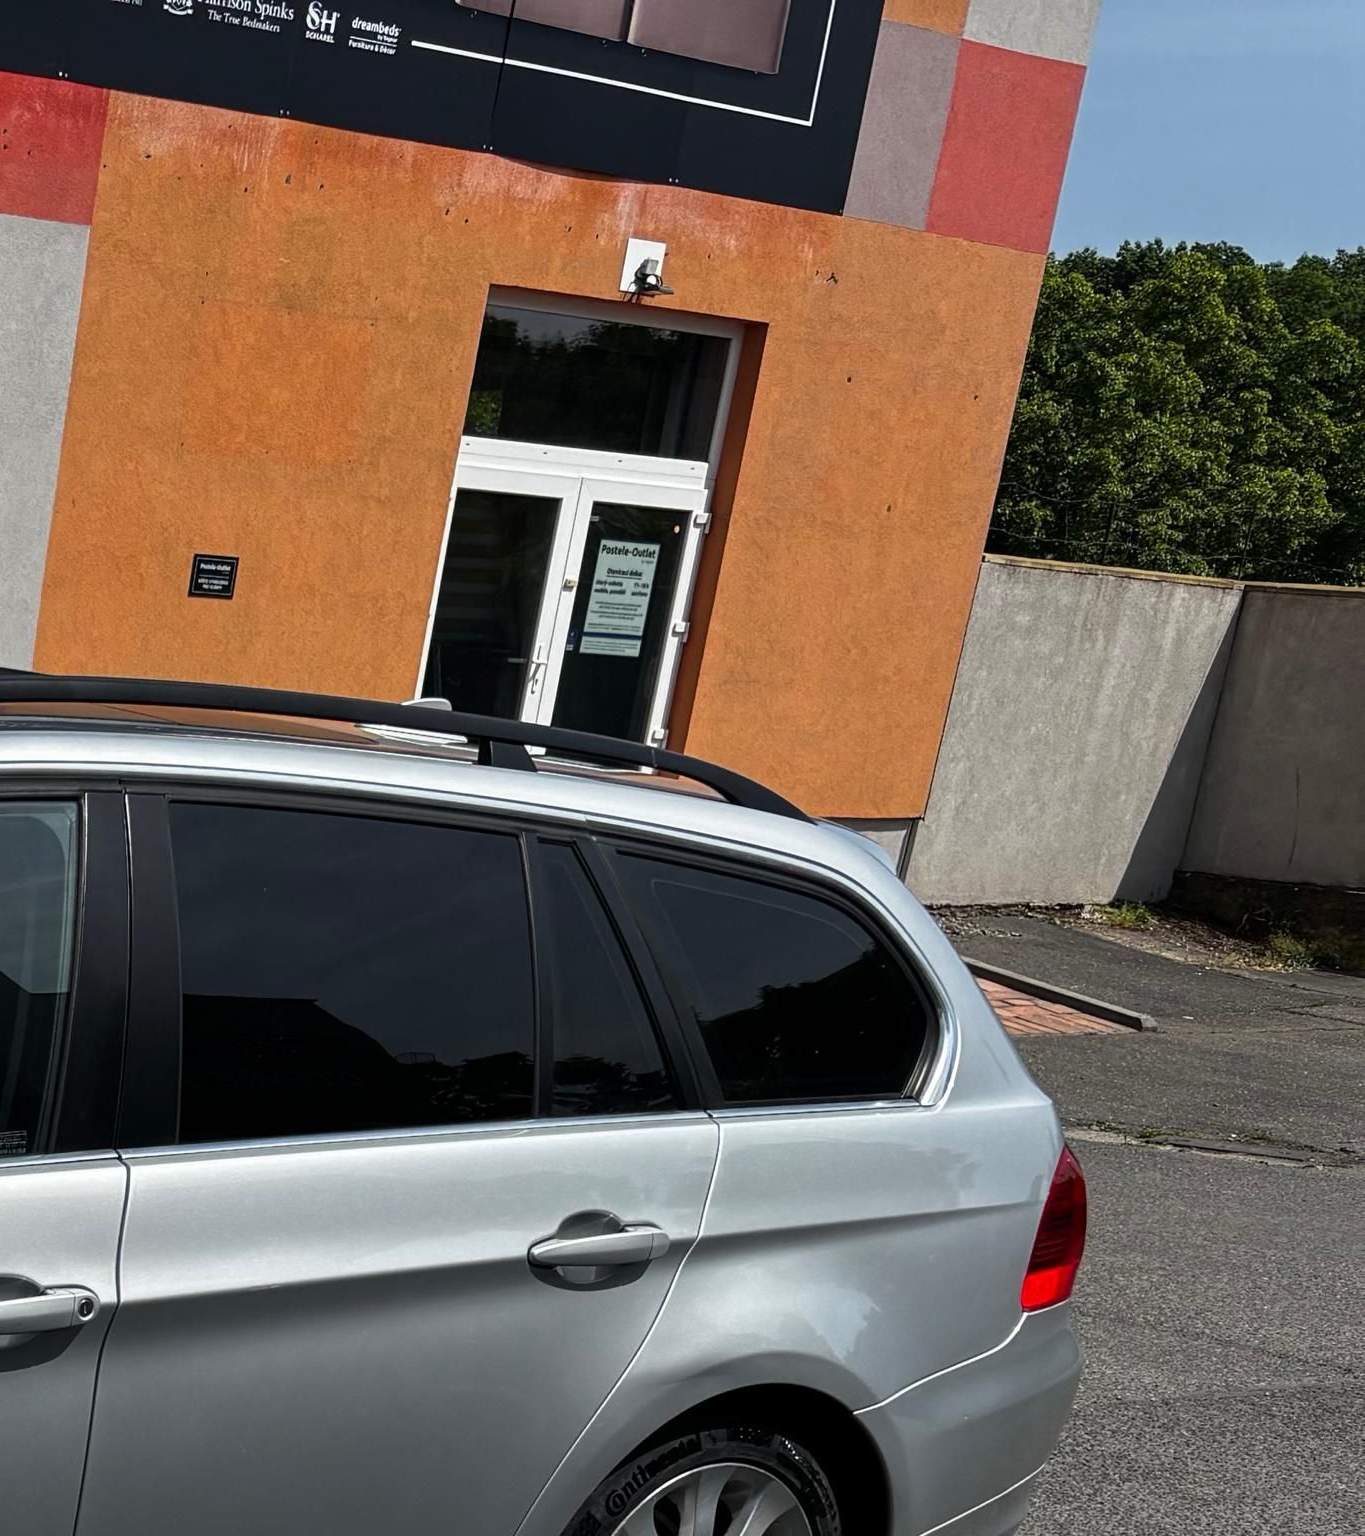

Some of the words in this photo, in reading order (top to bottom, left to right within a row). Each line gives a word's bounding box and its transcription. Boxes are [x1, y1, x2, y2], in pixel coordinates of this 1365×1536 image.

[208, 9, 222, 21] The
[224, 13, 240, 25] True
[255, 0, 294, 20] Spinks
[601, 544, 657, 560] Postele-Outlet
